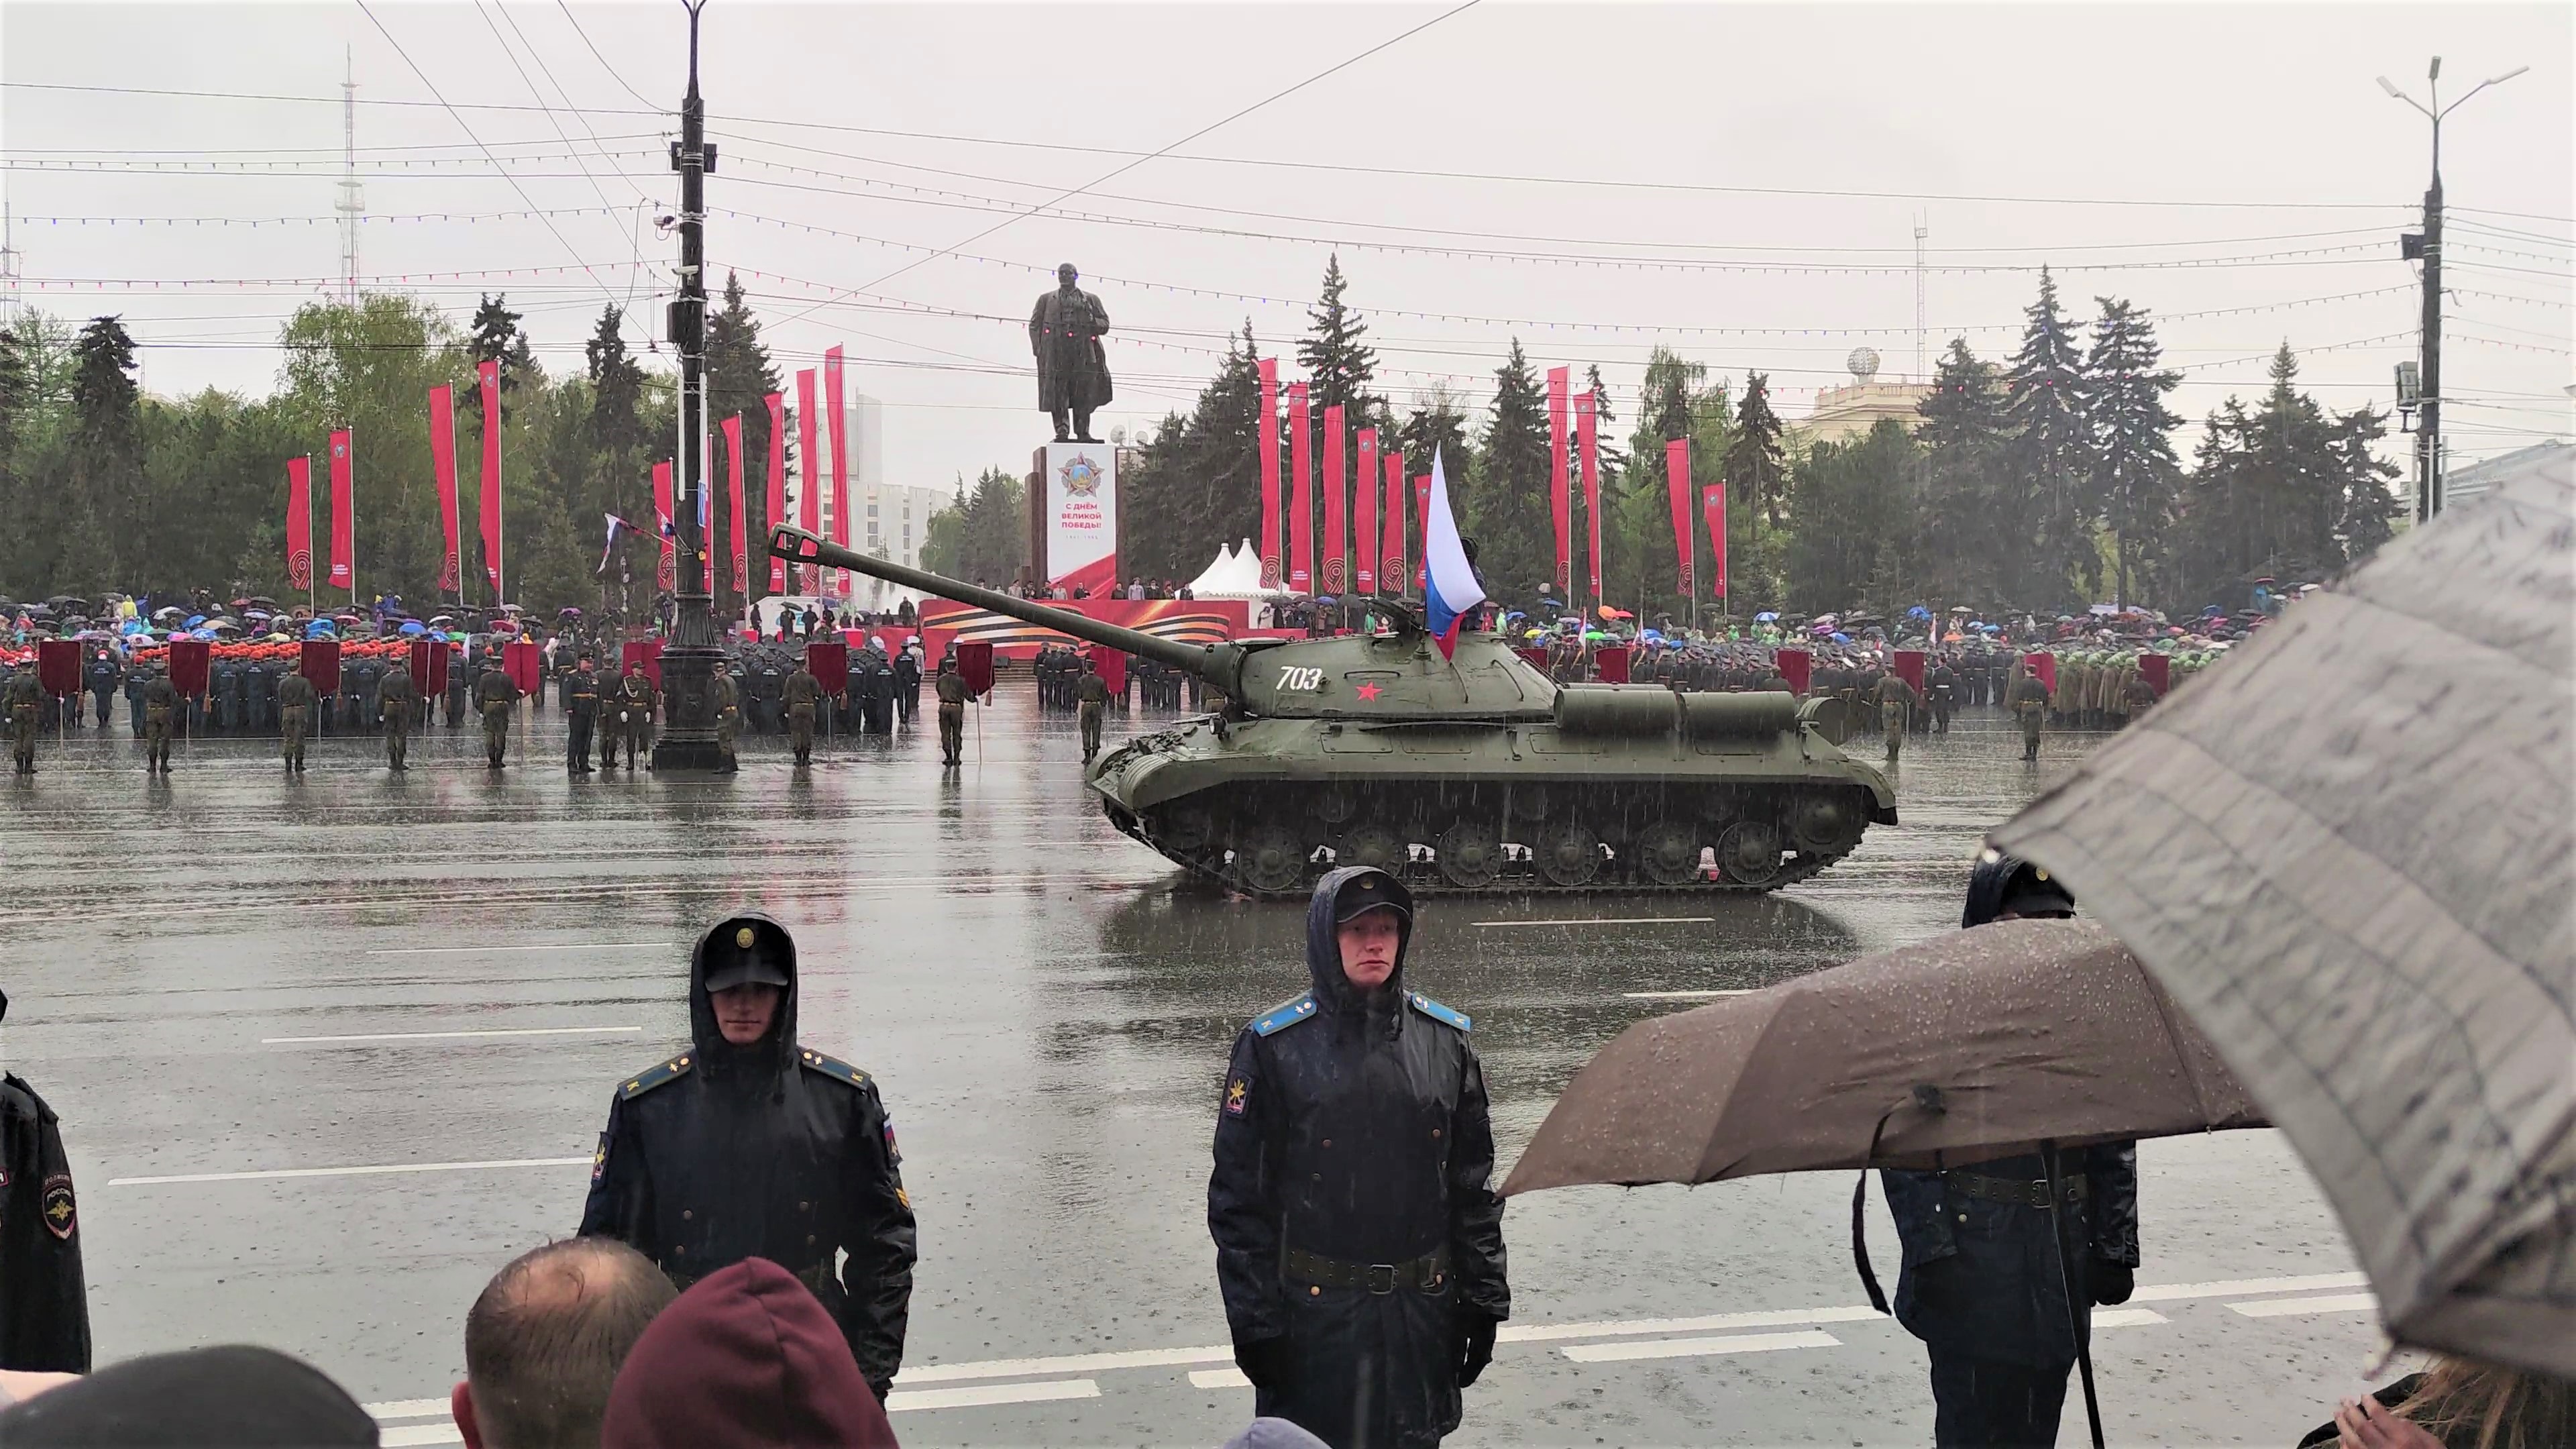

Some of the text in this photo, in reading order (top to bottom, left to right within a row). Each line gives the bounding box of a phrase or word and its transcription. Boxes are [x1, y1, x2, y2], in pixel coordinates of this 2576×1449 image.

[1073, 502, 1097, 511] ДНЁМ
[1061, 512, 1102, 520] ВЕЛИКОЙ
[1275, 665, 1322, 691] 703
